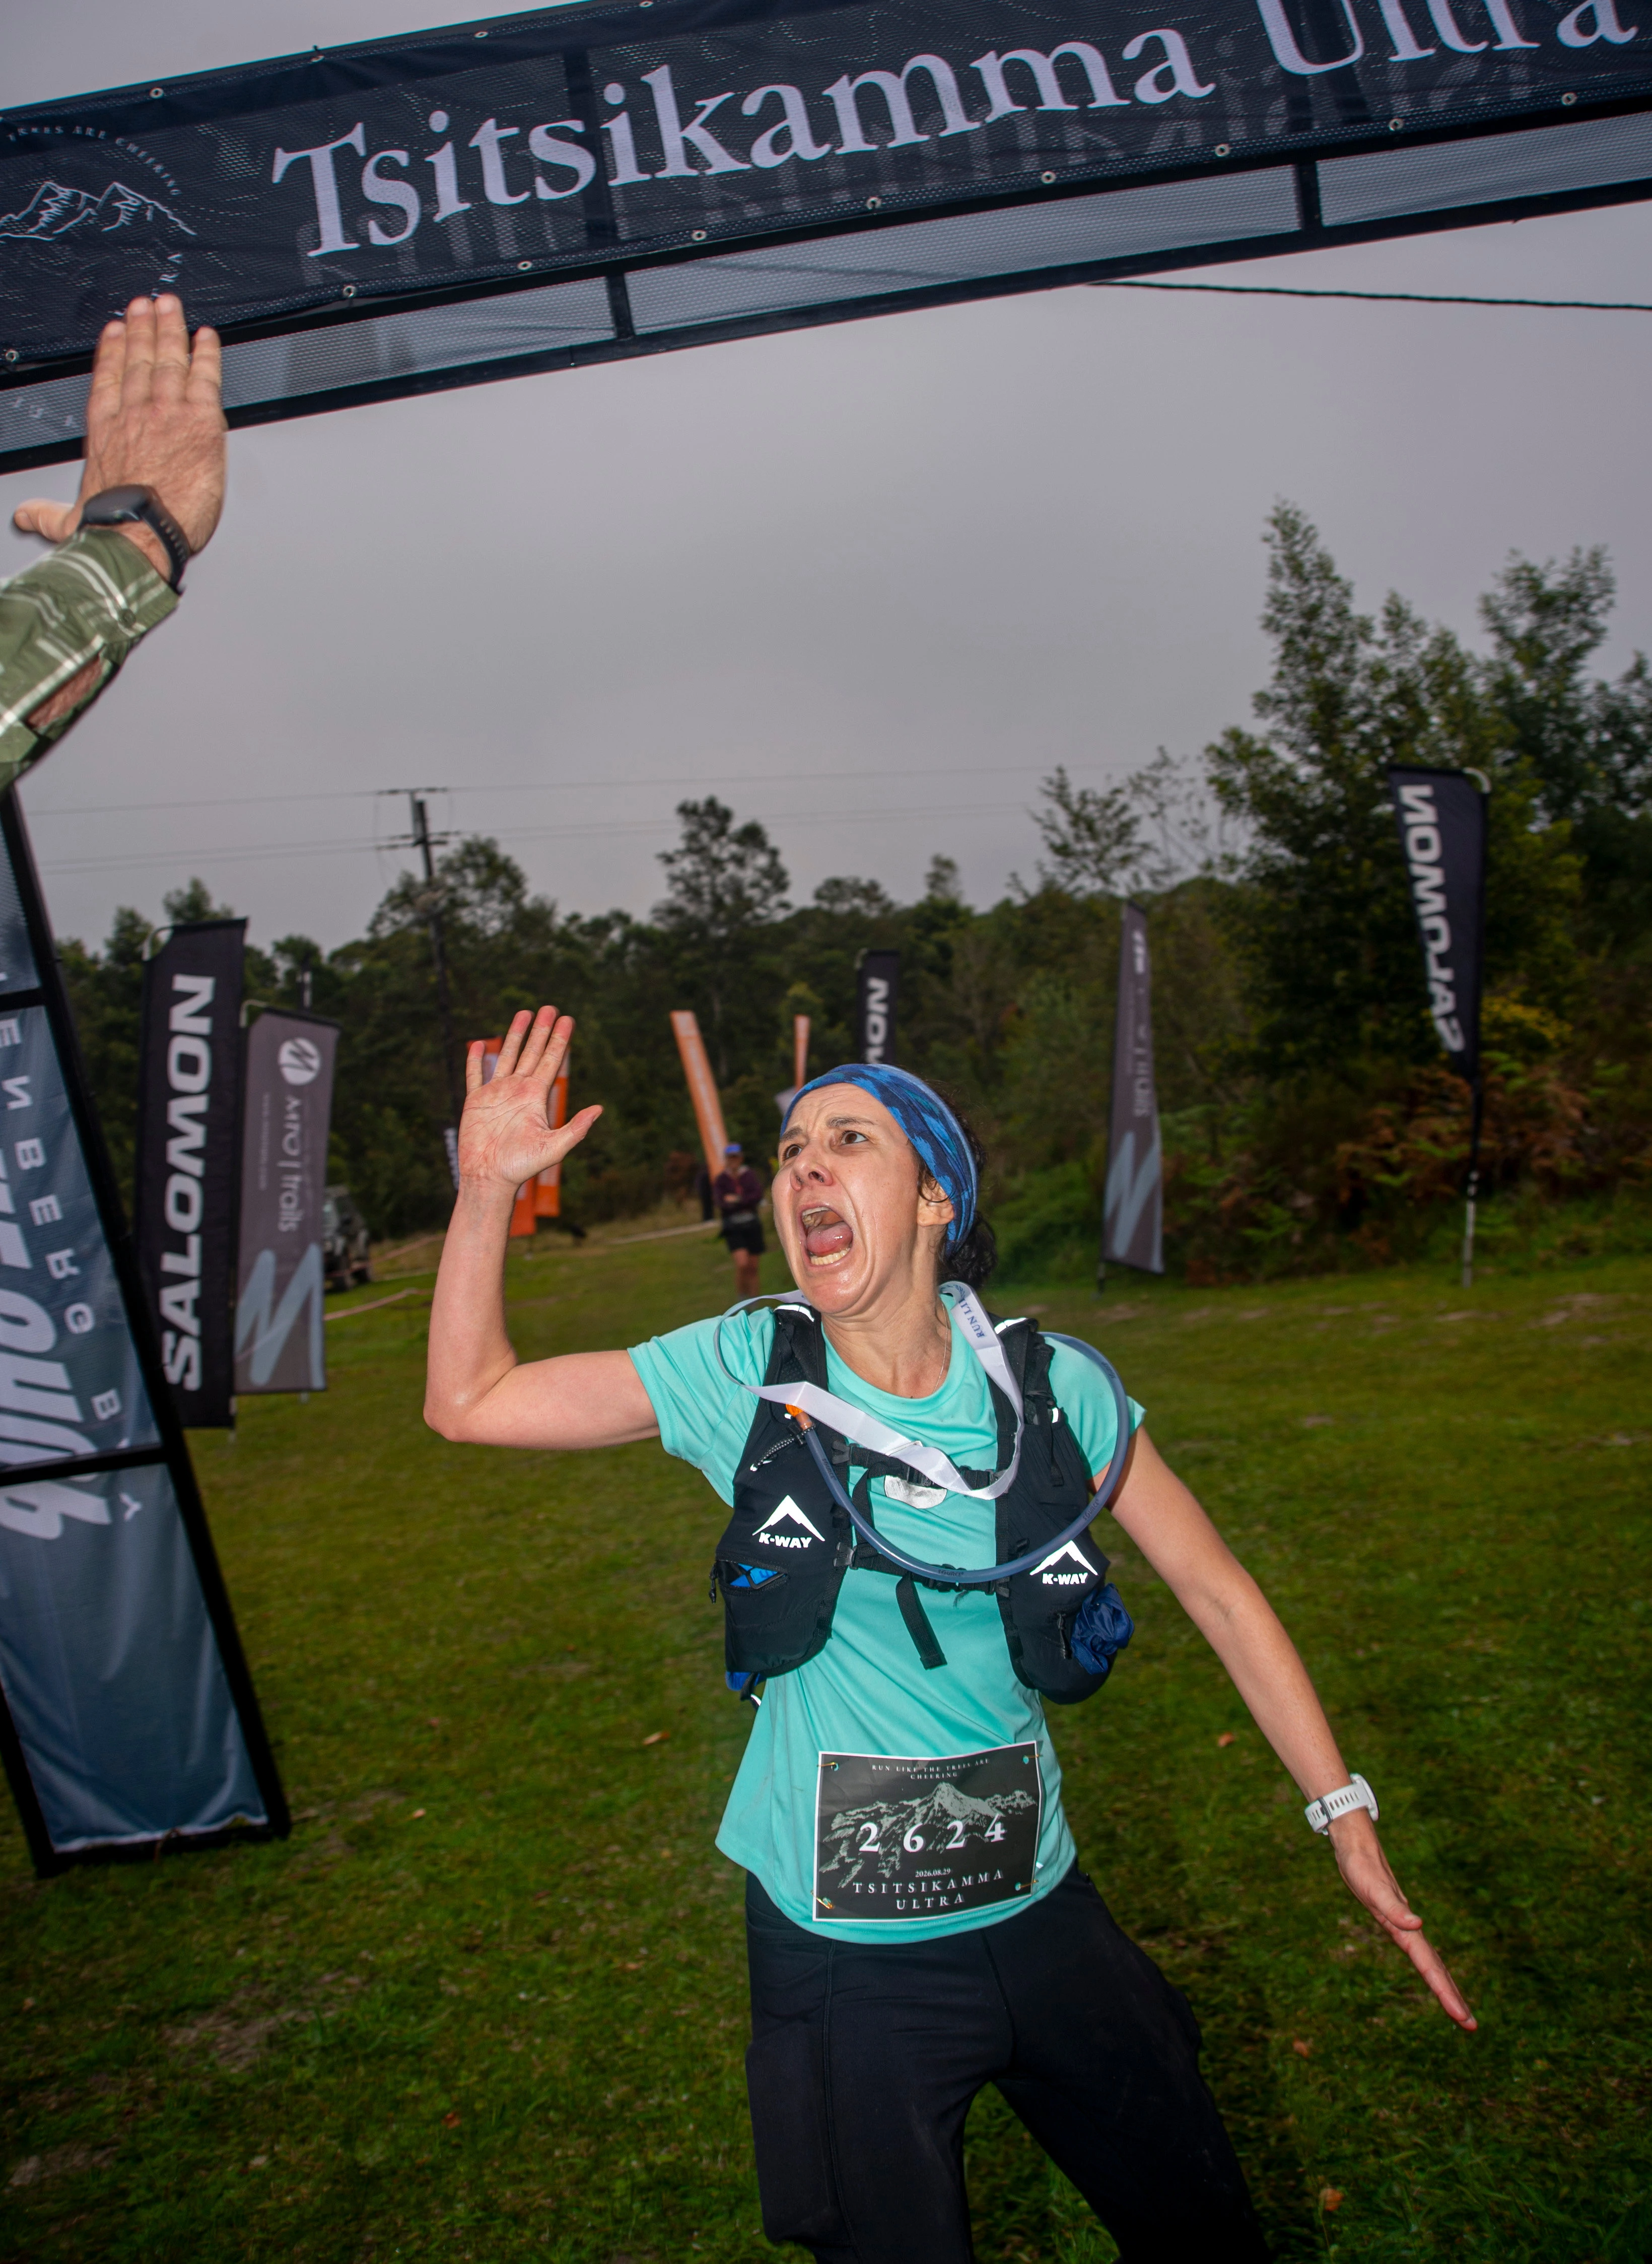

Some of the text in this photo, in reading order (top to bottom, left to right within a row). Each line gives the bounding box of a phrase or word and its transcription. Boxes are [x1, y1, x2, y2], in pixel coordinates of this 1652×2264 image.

[271, 29, 1215, 258] Tsitsikamma
[161, 973, 216, 1391] SALOMON
[968, 1316, 985, 1338] RUN
[759, 1532, 812, 1549] K-WAY
[1042, 1572, 1088, 1585] K-WAY
[911, 1771, 957, 1780] CHEERING
[859, 1814, 1006, 1852] 2624
[852, 1869, 1004, 1894] TSITSIKAMMA
[896, 1893, 965, 1910] ULTRA
